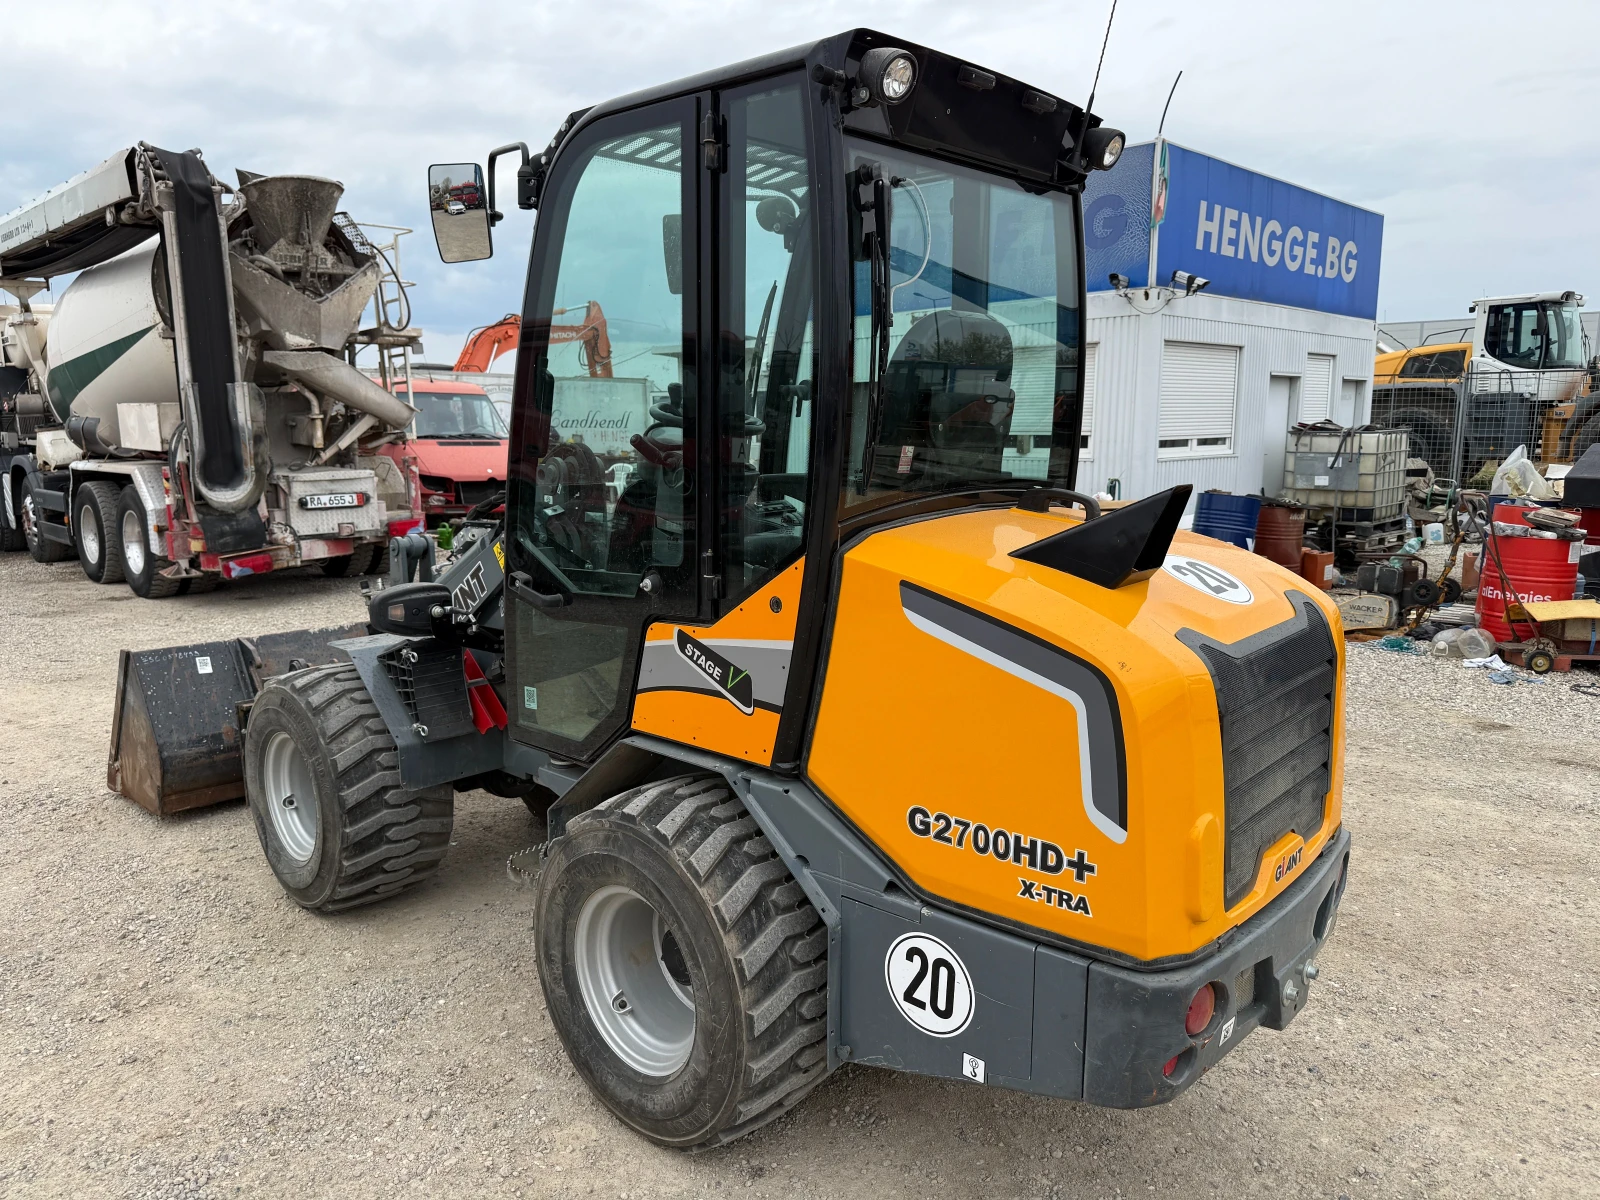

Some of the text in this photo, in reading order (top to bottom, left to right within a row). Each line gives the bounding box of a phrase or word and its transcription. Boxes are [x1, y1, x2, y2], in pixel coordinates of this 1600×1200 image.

[1196, 200, 1358, 283] HENGGE.BG
[1171, 561, 1239, 594] 20
[1350, 604, 1383, 613] WACKER
[685, 643, 722, 681] STAGE
[907, 805, 1097, 883] G2700HD+
[1017, 877, 1092, 917] X-TRA
[903, 946, 956, 1020] 20
